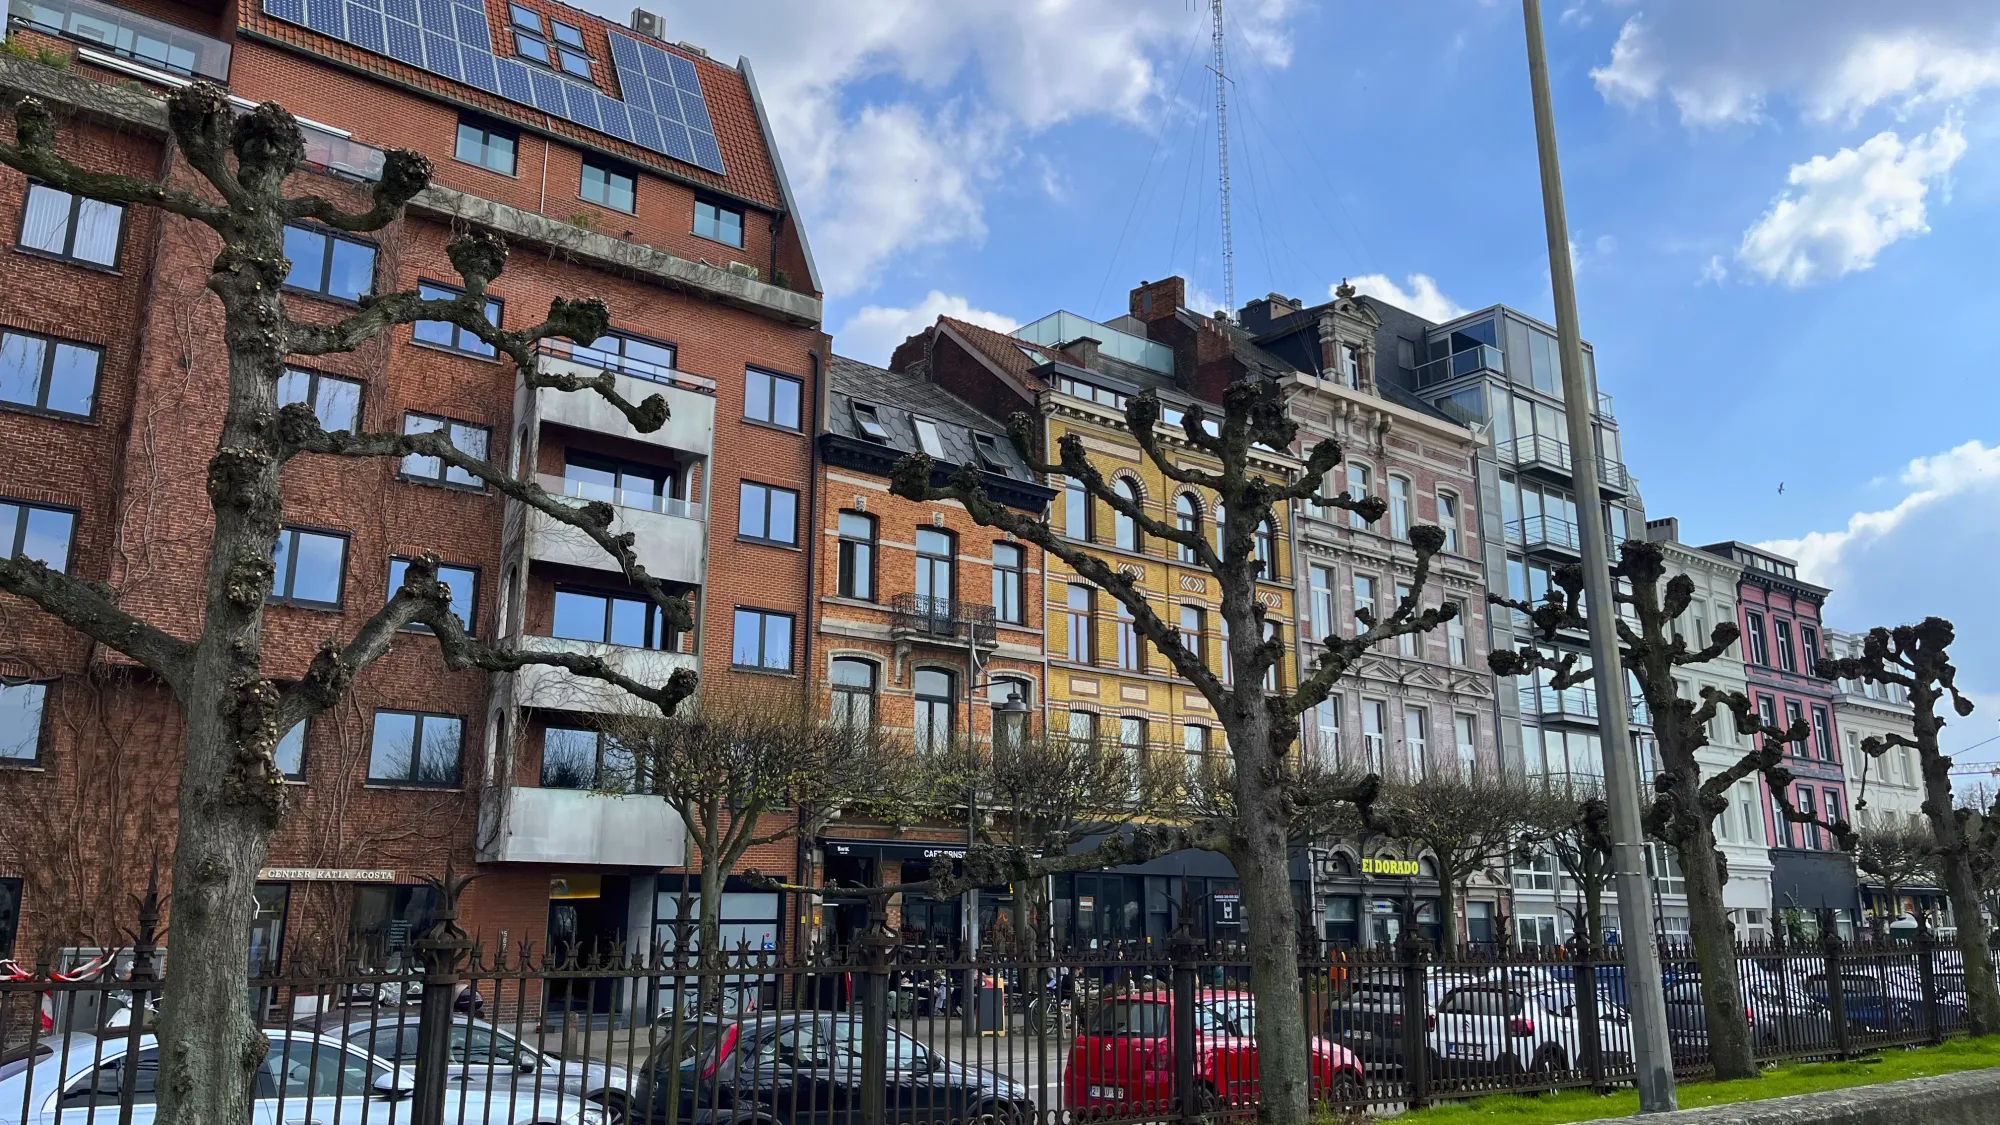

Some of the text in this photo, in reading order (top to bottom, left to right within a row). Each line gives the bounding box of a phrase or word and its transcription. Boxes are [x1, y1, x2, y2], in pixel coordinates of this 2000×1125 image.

[1374, 859, 1419, 875] DORADO
[267, 869, 312, 879] CENTER
[316, 869, 350, 879] KATIA
[354, 871, 393, 880] ACOSTA
